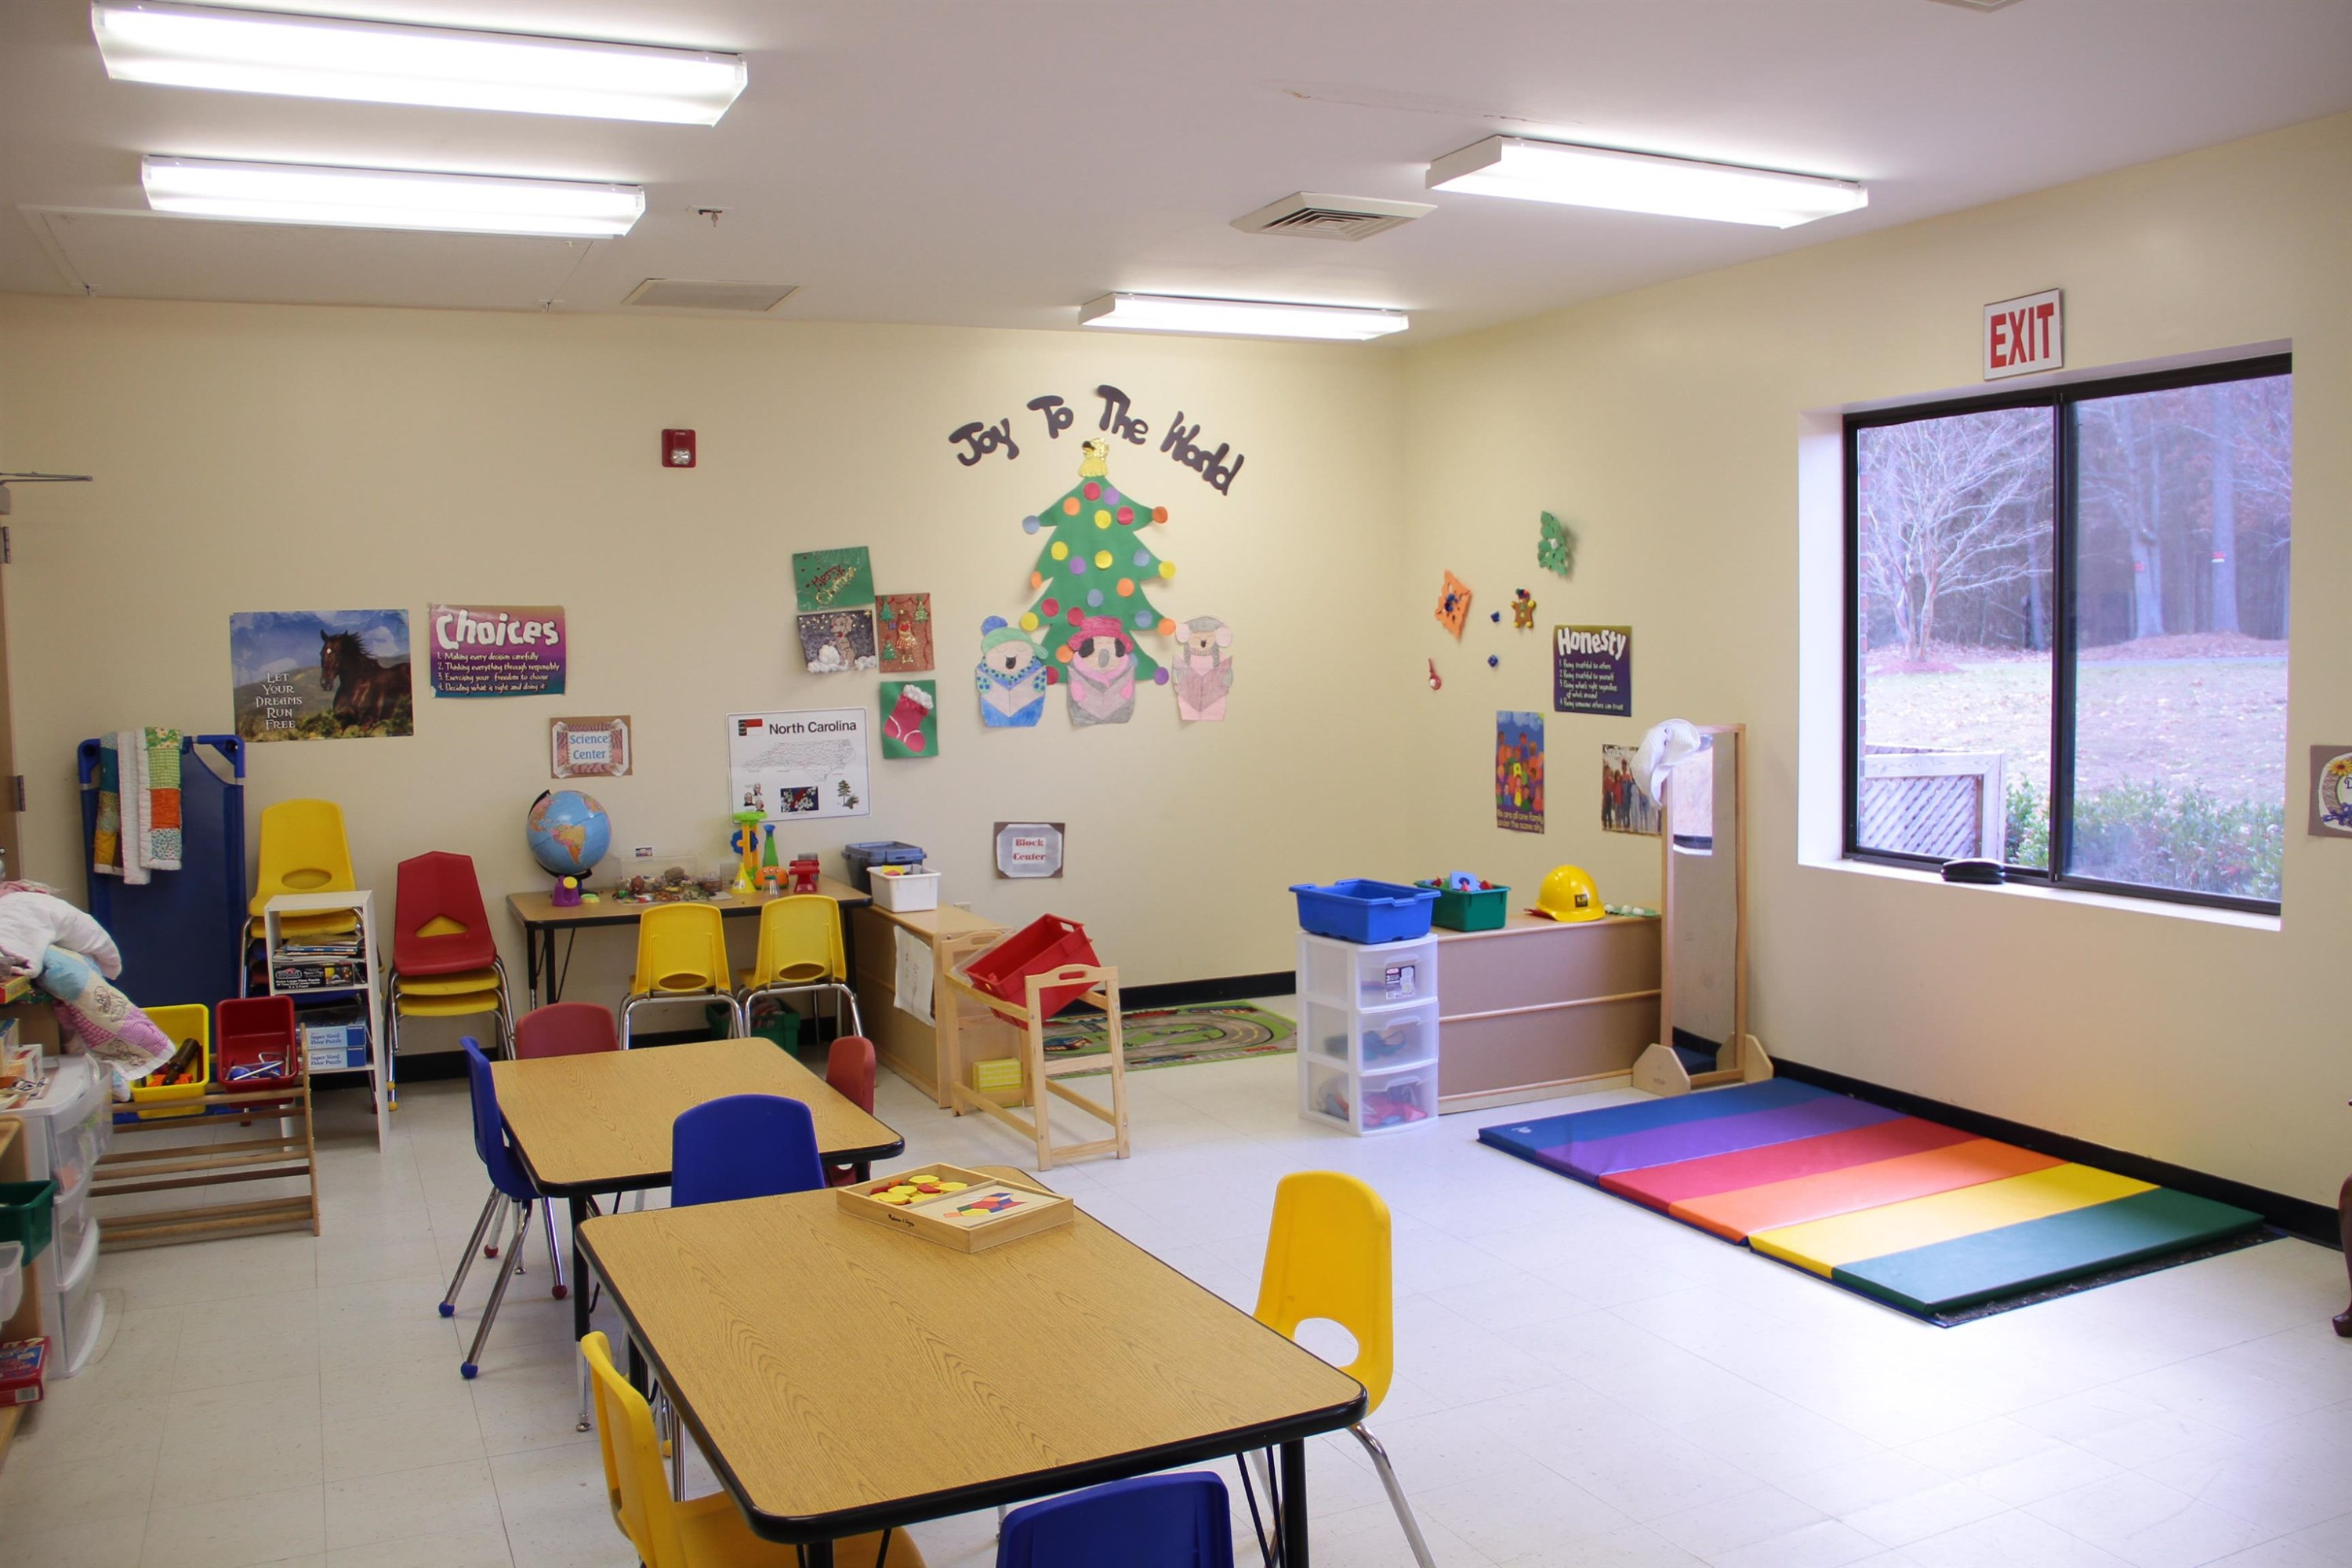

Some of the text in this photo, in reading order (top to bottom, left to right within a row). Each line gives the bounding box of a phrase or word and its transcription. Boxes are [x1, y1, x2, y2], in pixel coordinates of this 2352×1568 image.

[1990, 302, 2054, 368] EXIT
[948, 384, 1244, 496] Joy To The World
[436, 609, 559, 650] Choices
[1558, 627, 1626, 660] Honesty
[445, 652, 468, 663] Making
[512, 652, 539, 661] carefully
[445, 662, 470, 673] Thinking
[471, 662, 503, 673] everything
[504, 662, 527, 673] through
[528, 662, 560, 672] responsibly
[267, 673, 289, 684] LET
[445, 673, 474, 684] Exercising
[495, 672, 518, 681] freedom
[262, 684, 295, 695] YOUR
[445, 682, 469, 693] Deciding
[495, 683, 509, 694] right
[510, 682, 522, 691] and
[523, 682, 539, 692] doing
[255, 696, 303, 708] DREAMS
[267, 707, 293, 719] RUN
[265, 719, 296, 731] FREE
[769, 720, 857, 735] North Carolina
[569, 733, 608, 745] Science
[573, 750, 606, 760] Center
[1015, 838, 1044, 847] Block
[1013, 852, 1046, 861] Center
